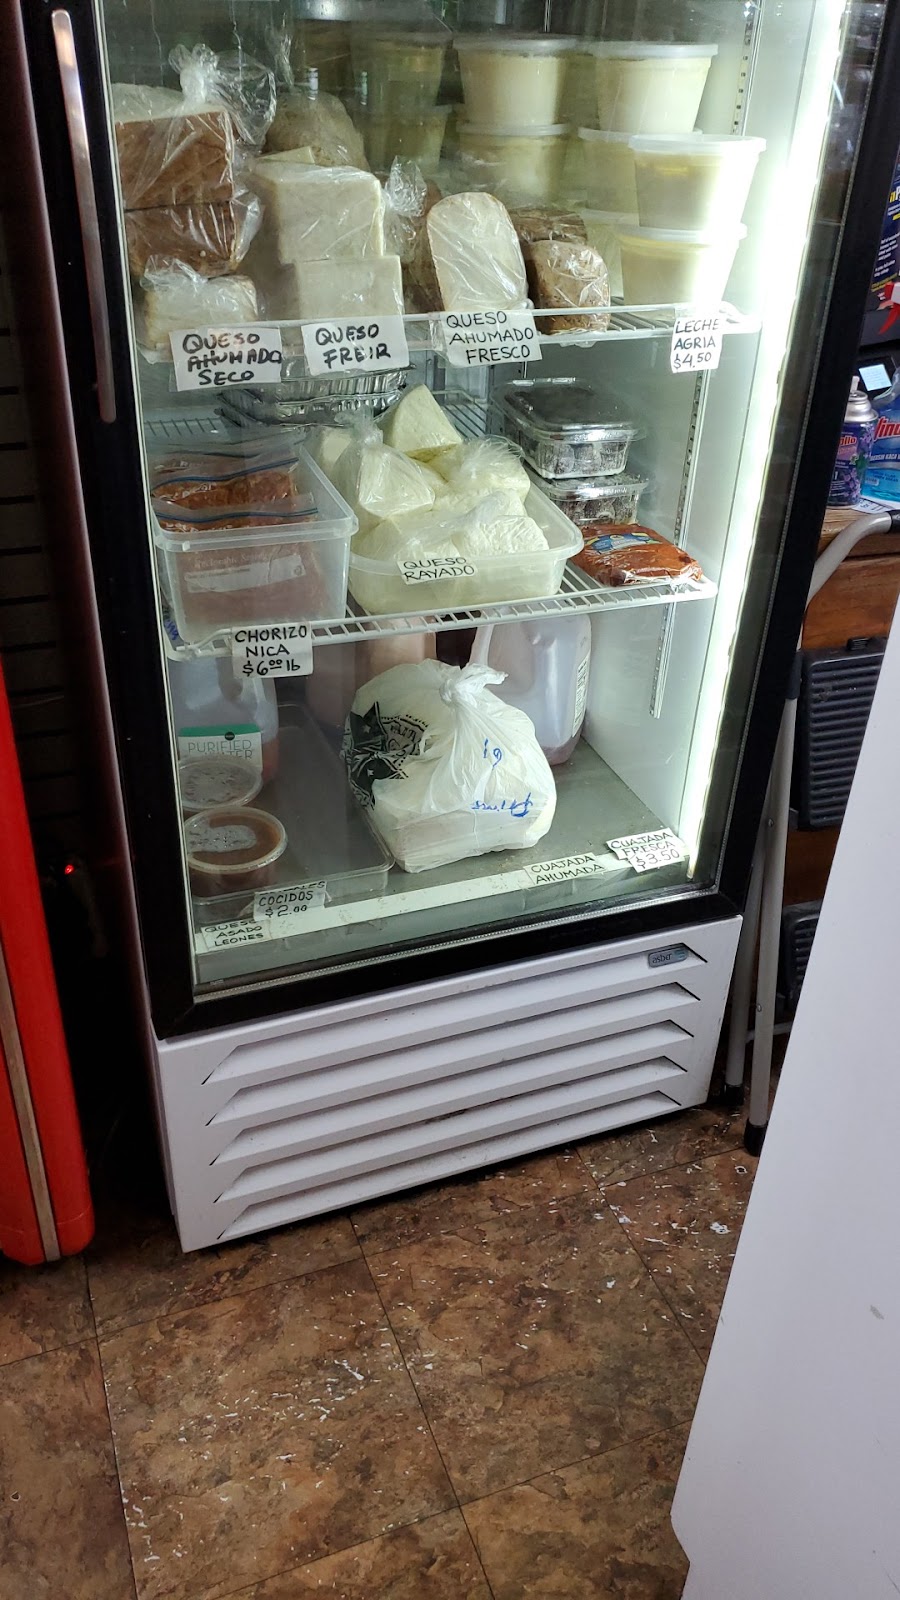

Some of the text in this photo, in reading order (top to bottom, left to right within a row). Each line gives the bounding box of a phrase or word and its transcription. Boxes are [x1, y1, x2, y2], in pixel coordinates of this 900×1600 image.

[446, 311, 508, 328] QUESO
[675, 318, 719, 334] LECHE
[182, 332, 260, 353] QUESO
[316, 324, 380, 346] QUESO
[449, 326, 534, 346] AHUMADO
[674, 337, 716, 350] AGRIA
[187, 348, 282, 372] AHUMADO
[323, 343, 392, 368] FREIR
[466, 347, 530, 364] FRESCO
[673, 352, 712, 370] $4.50
[198, 370, 255, 386] SECO
[403, 557, 467, 570] QUESO
[404, 565, 475, 582] RAYADO
[235, 625, 308, 643] CHORIZO
[245, 645, 290, 658] NICA
[188, 740, 252, 755] PURIFIED
[611, 832, 673, 848] CUAJADA
[622, 841, 676, 856] FRESCA
[532, 855, 595, 874] CUAJADA
[636, 848, 680, 869] $3.50
[536, 864, 606, 884] AHUMADA
[259, 890, 314, 906] COCIDOS
[265, 904, 308, 918] $2.00
[214, 933, 264, 946] LEONES
[216, 926, 262, 938] ASADO
